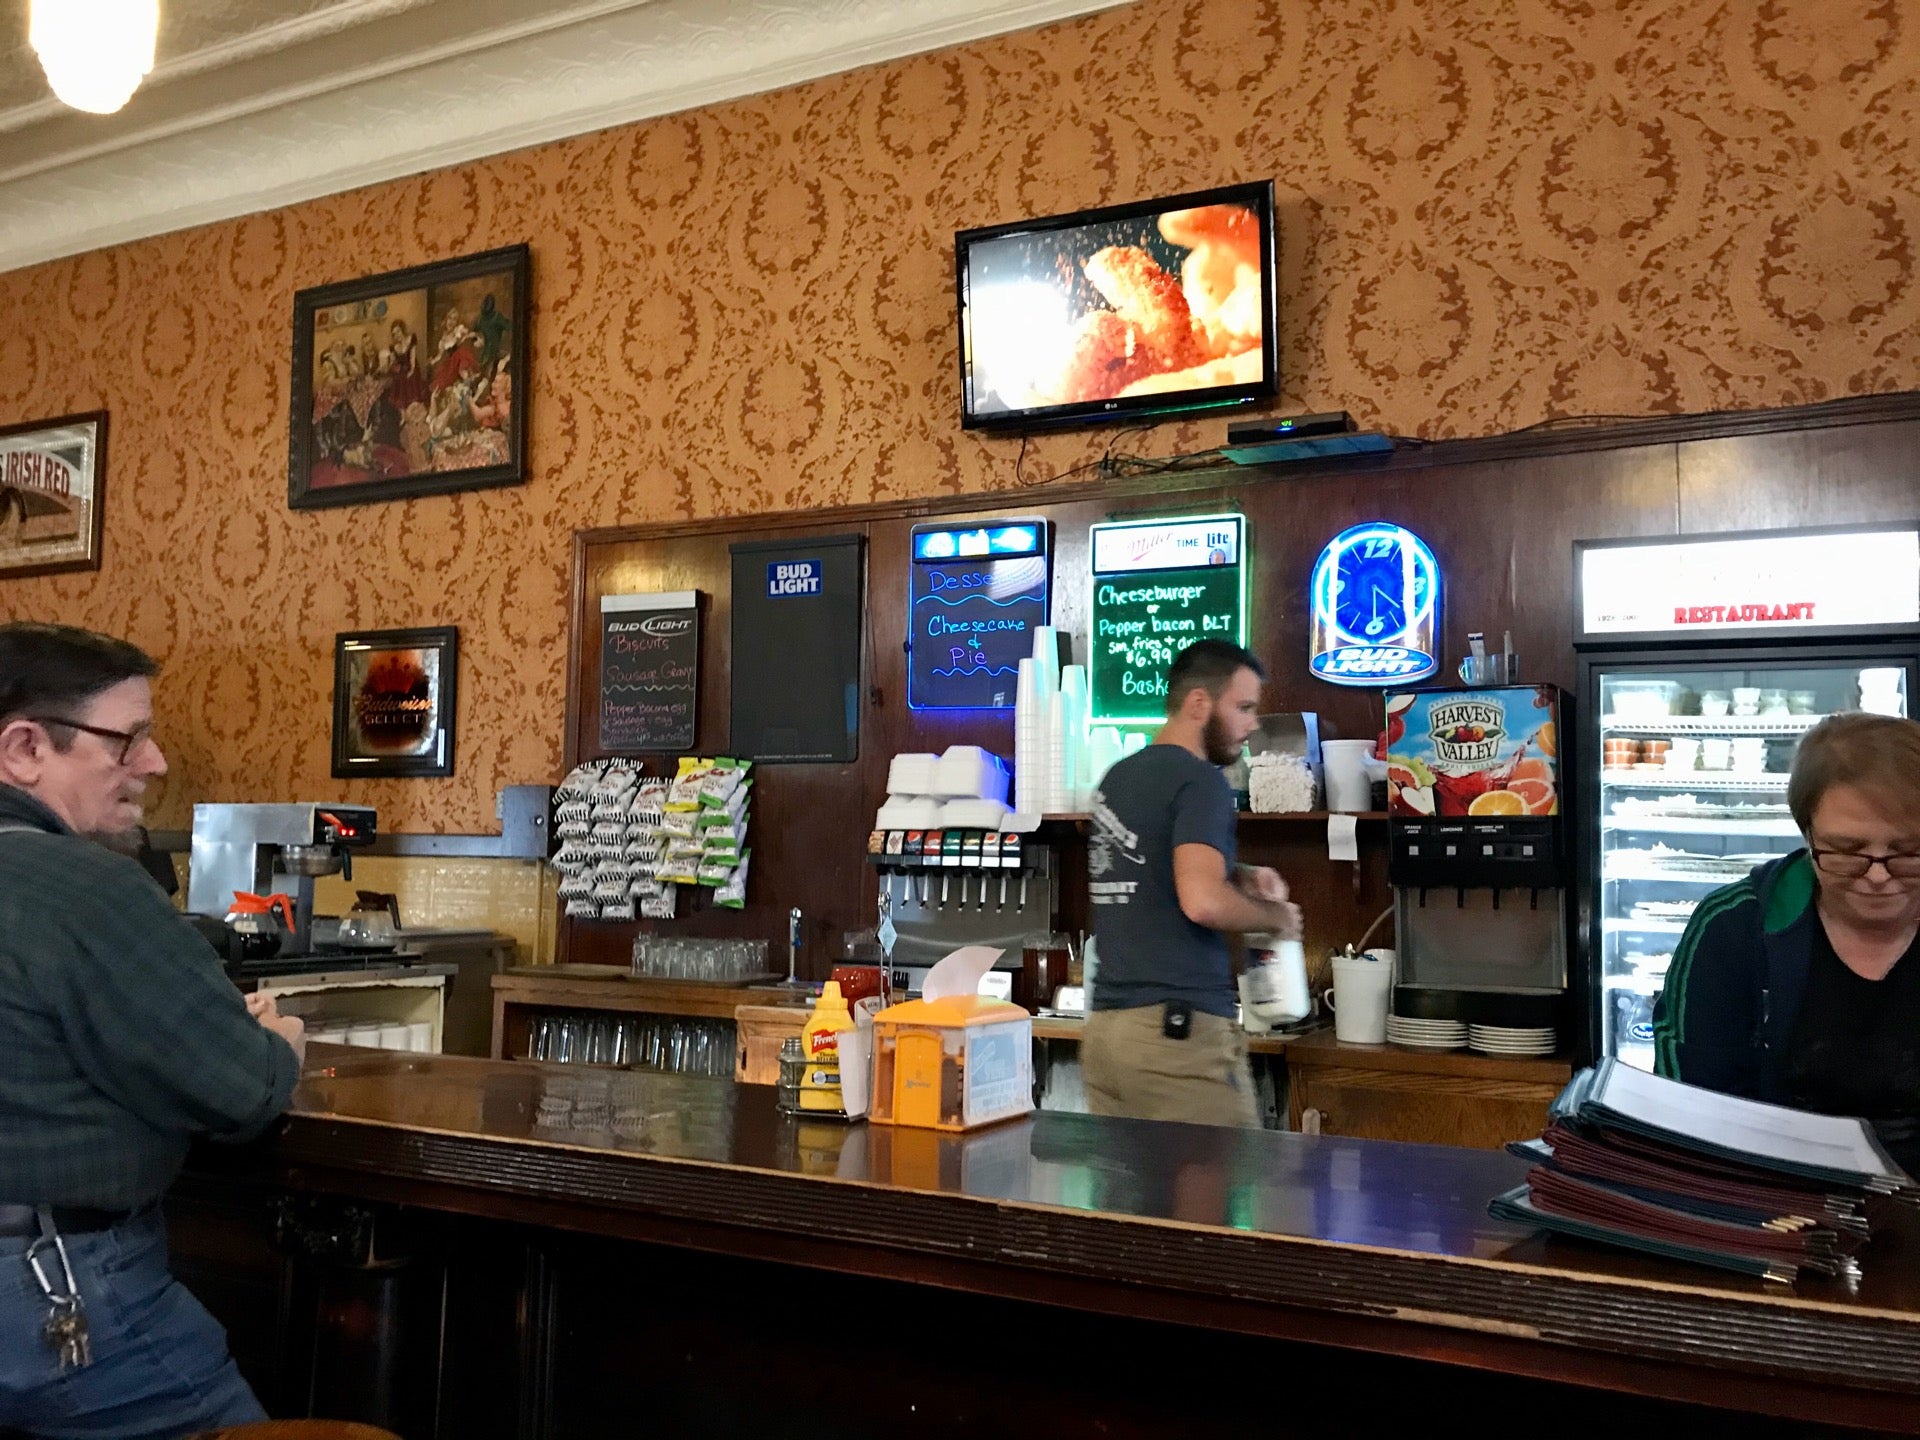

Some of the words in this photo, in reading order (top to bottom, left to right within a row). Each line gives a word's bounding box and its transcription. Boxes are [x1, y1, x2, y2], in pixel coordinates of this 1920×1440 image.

[6, 452, 41, 486] IRISH
[45, 457, 70, 498] RED
[1177, 539, 1199, 547] TIME
[1207, 533, 1229, 547] Lite
[1364, 539, 1393, 558] 12
[777, 564, 812, 580] BUD
[770, 577, 819, 595] LIGHT
[1099, 585, 1206, 608] Cheeseburger
[1146, 604, 1160, 614] or
[1675, 602, 1816, 624] RESTAURANT
[608, 622, 640, 632] BUD
[647, 620, 692, 631] LIGHT
[928, 615, 1025, 636] Cheesecake
[1099, 619, 1146, 638] Pepper
[1151, 615, 1195, 632] bacon
[1202, 614, 1231, 631] BLT
[1365, 617, 1385, 635] 6
[1132, 636, 1162, 650] fries
[950, 647, 987, 667] Pie
[1125, 647, 1172, 668] $6.99
[1336, 649, 1409, 660] BUD
[1322, 661, 1421, 672] LIGHT
[364, 714, 419, 725] SELECT
[1434, 706, 1500, 729] HARVEST
[1441, 741, 1494, 761] VALLEY
